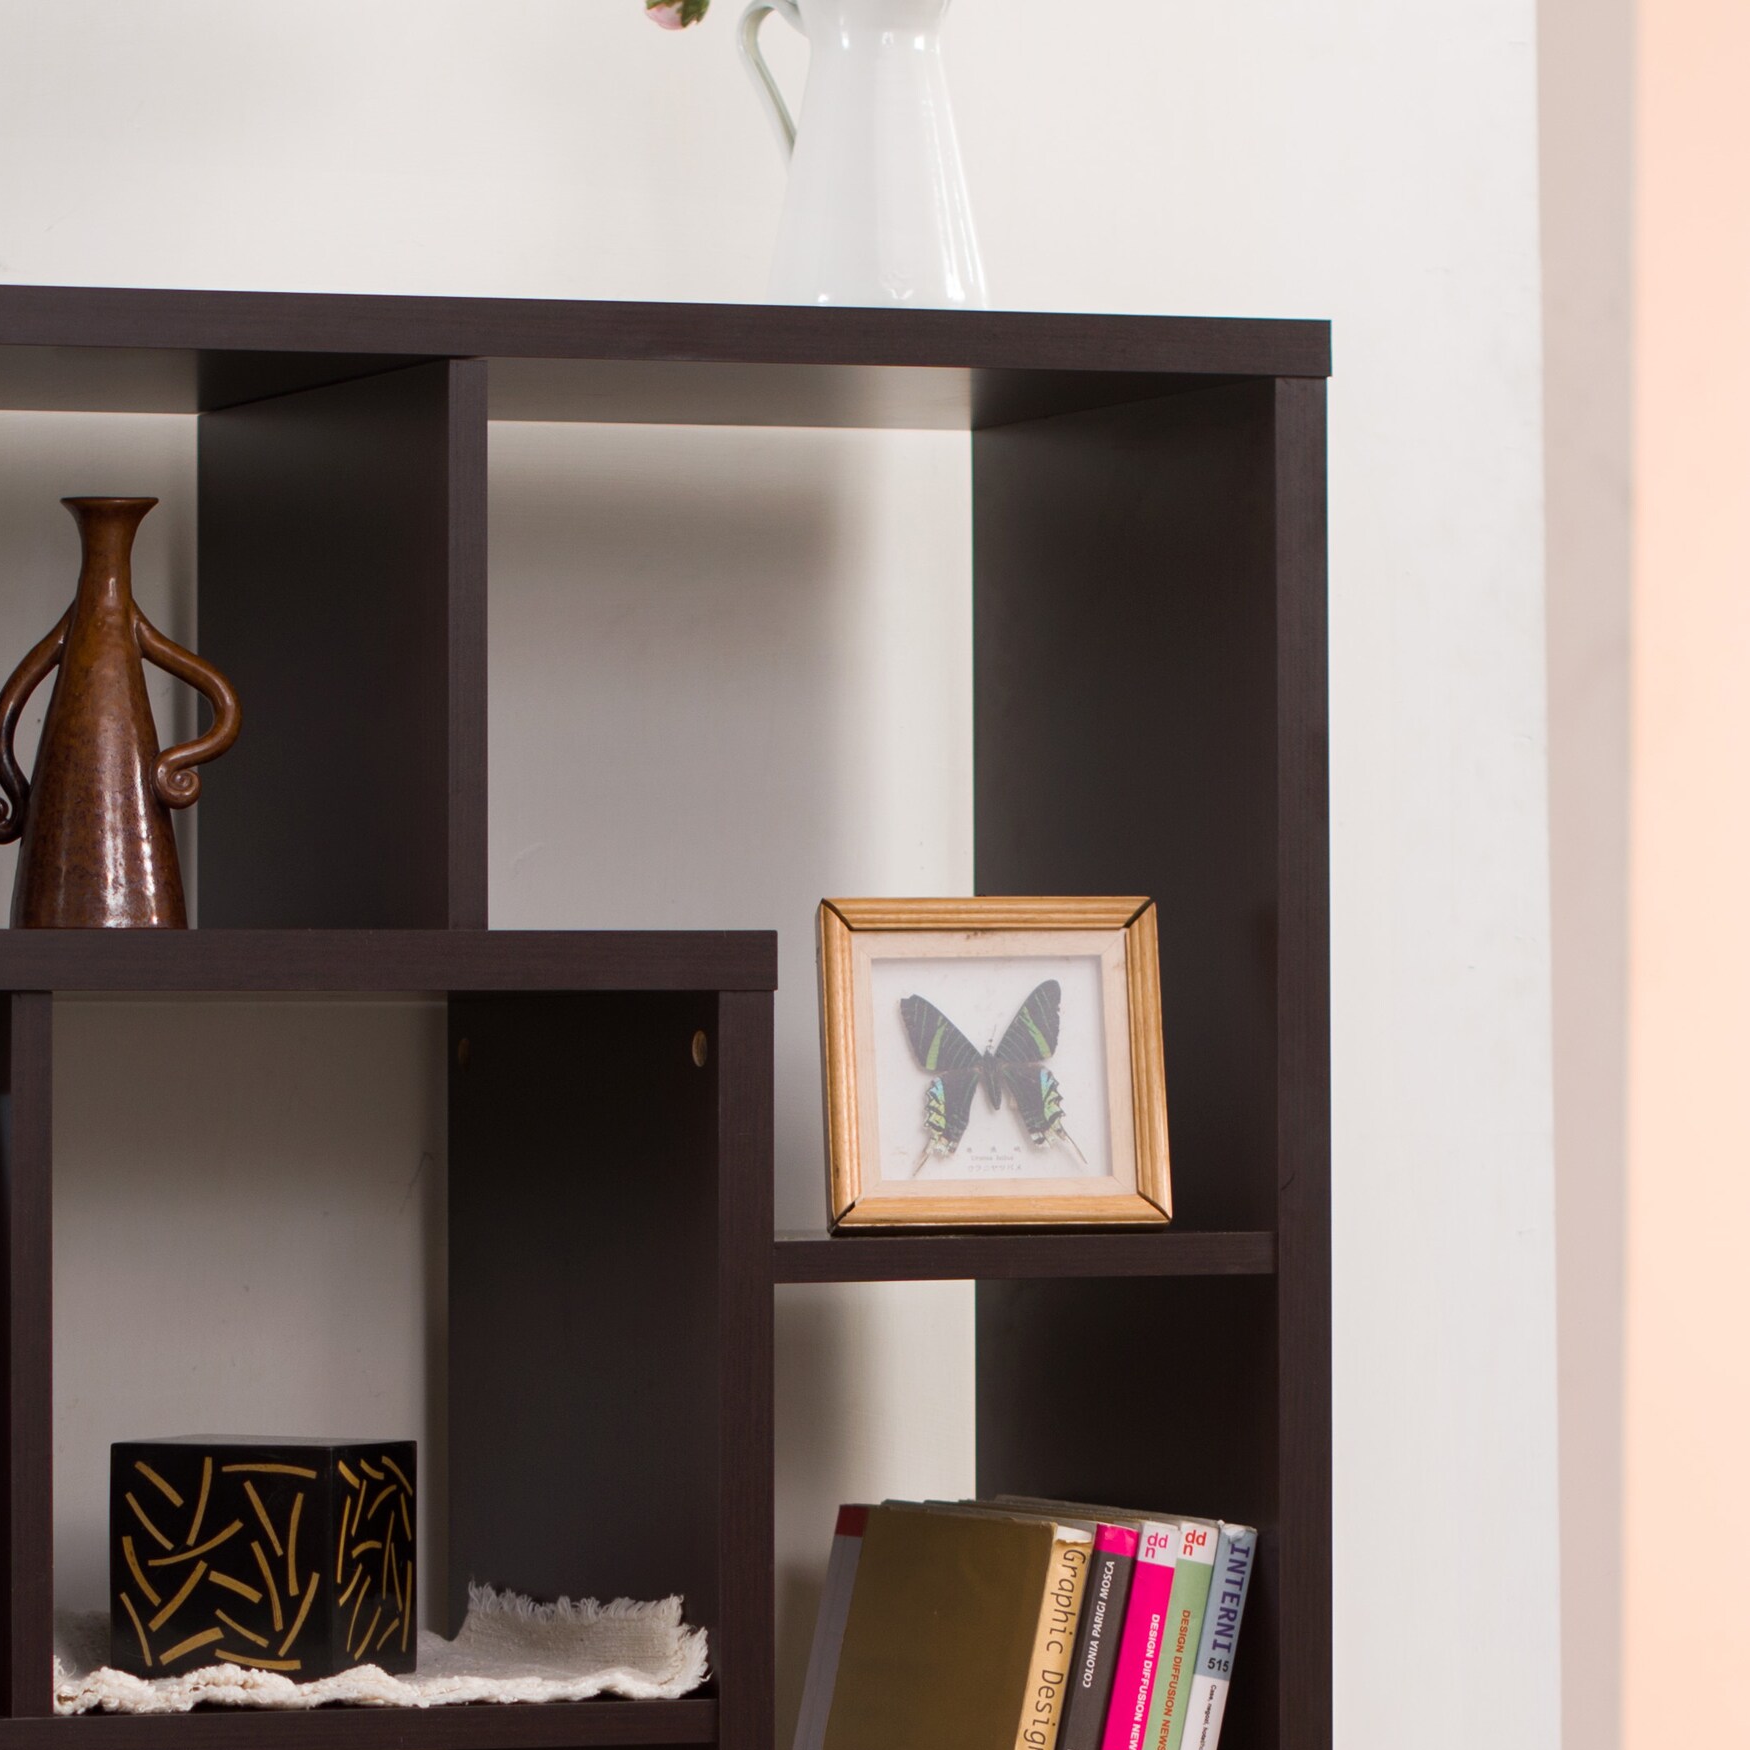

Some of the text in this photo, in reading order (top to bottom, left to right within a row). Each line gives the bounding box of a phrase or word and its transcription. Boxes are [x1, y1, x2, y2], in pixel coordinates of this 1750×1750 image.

[1046, 1549, 1086, 1654] Graphic
[1082, 1640, 1099, 1689] COLONIA
[1092, 1600, 1106, 1638] PARIGI
[1100, 1560, 1115, 1600] MOSCA
[1212, 1543, 1250, 1653] INTERNI
[1145, 1613, 1161, 1658] DESIGN
[1176, 1609, 1191, 1654] DESIGN
[1135, 1659, 1153, 1722] DIFFUSION
[1164, 1655, 1183, 1717] DIFFUSION
[1207, 1657, 1230, 1673] 515
